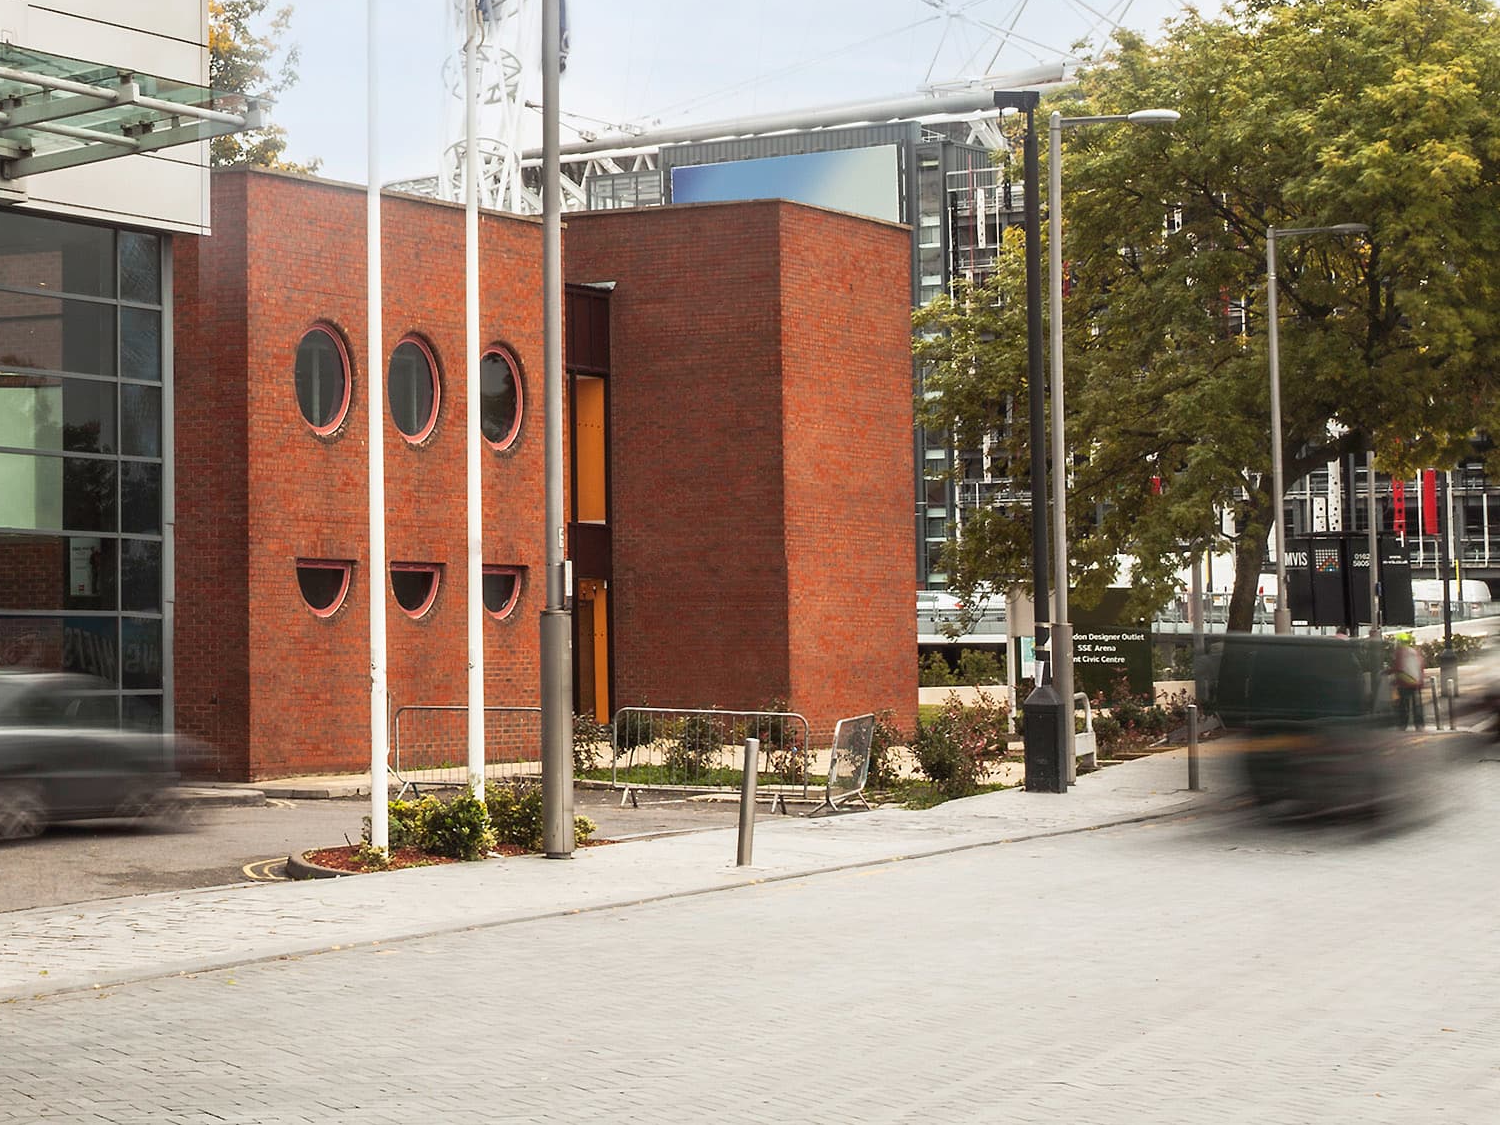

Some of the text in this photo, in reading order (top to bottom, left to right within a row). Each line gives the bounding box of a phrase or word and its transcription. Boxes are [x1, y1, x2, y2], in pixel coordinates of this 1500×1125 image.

[1284, 552, 1308, 566] MVIS
[1072, 633, 1145, 642] don Designer Outlet
[1077, 644, 1117, 652] SSE Arena
[1082, 655, 1100, 663] Civic
[1100, 655, 1126, 663] Centre
